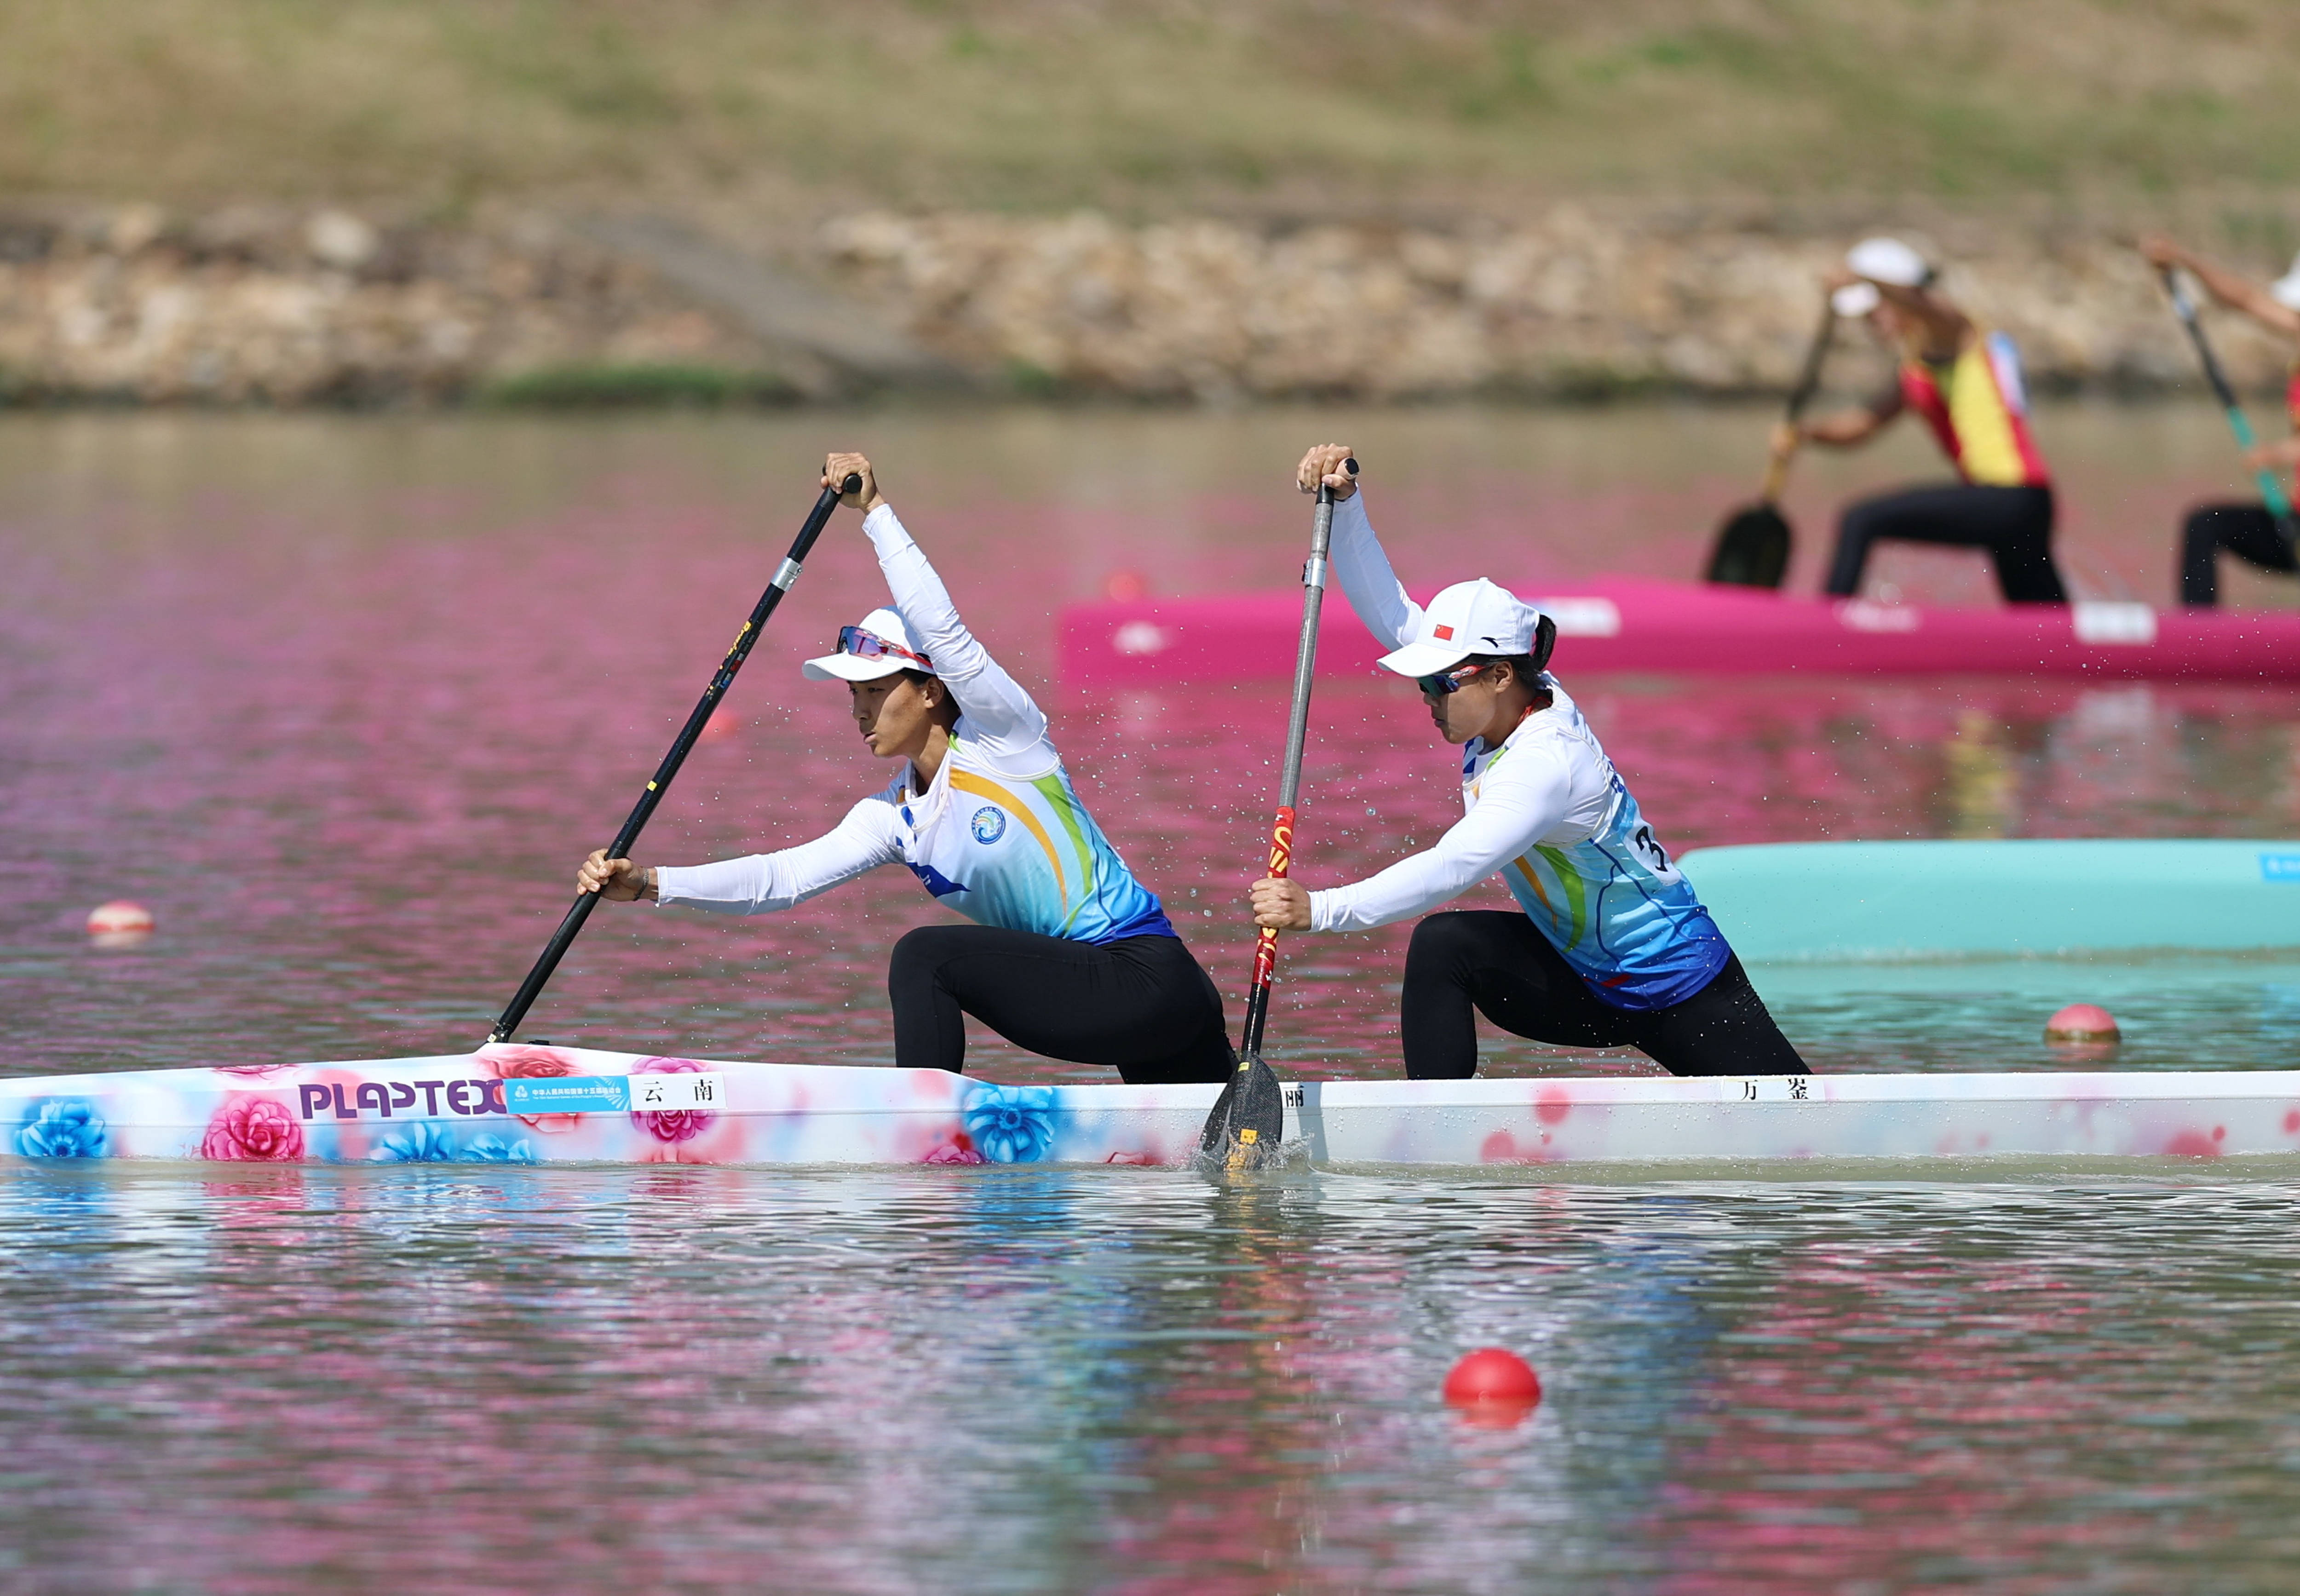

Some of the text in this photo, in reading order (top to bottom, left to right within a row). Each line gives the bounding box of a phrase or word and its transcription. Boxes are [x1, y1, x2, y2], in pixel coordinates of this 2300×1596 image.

[1635, 826, 1668, 872] 3
[298, 1079, 507, 1119] PLASTEX
[641, 1079, 713, 1102] 云南
